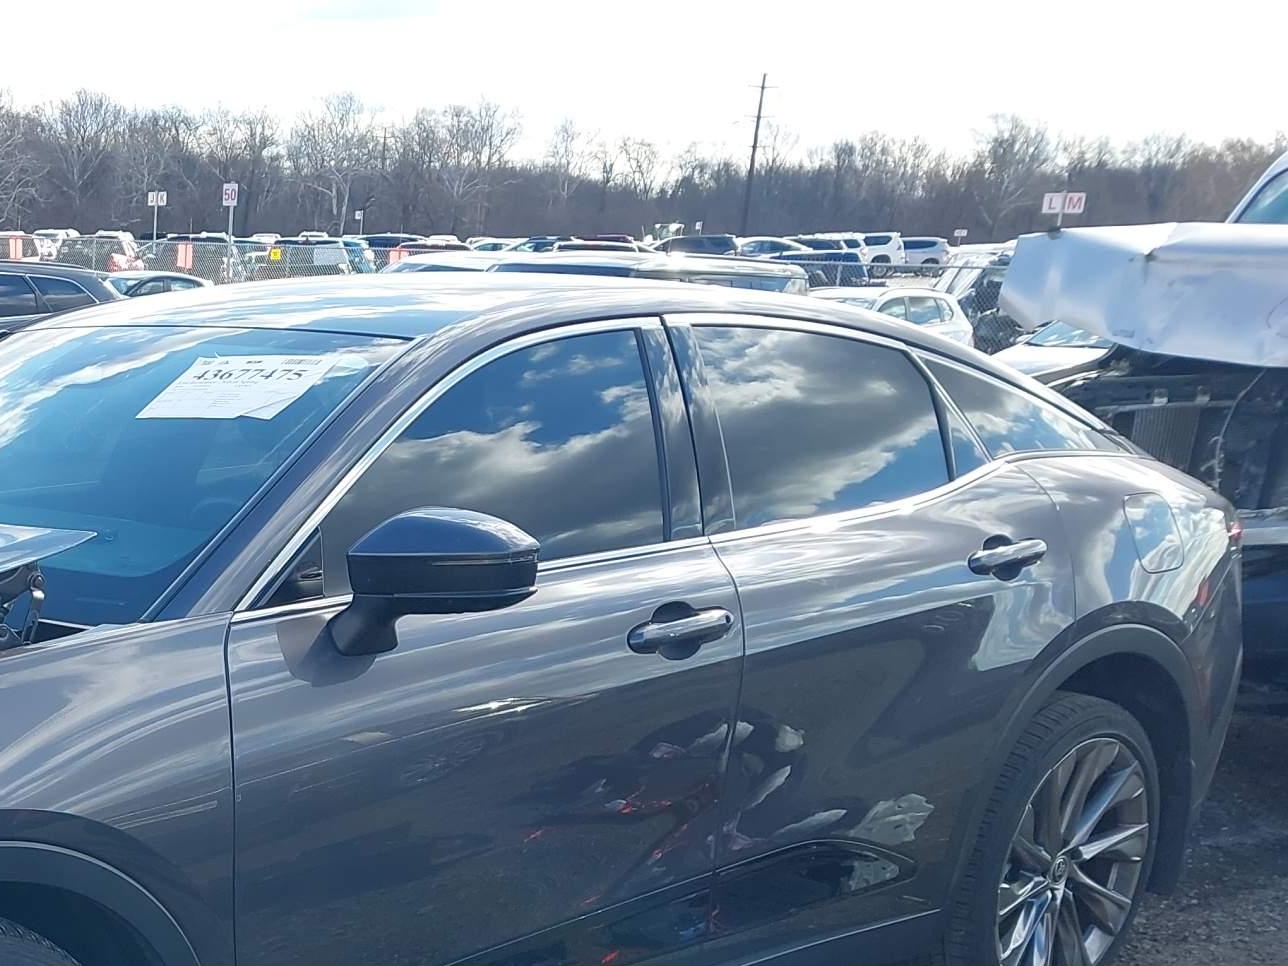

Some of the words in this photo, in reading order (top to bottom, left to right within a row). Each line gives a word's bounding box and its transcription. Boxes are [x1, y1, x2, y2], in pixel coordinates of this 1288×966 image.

[224, 188, 237, 201] 50
[1047, 197, 1057, 210] L
[1066, 196, 1082, 209] M
[192, 368, 310, 381] 43677475
